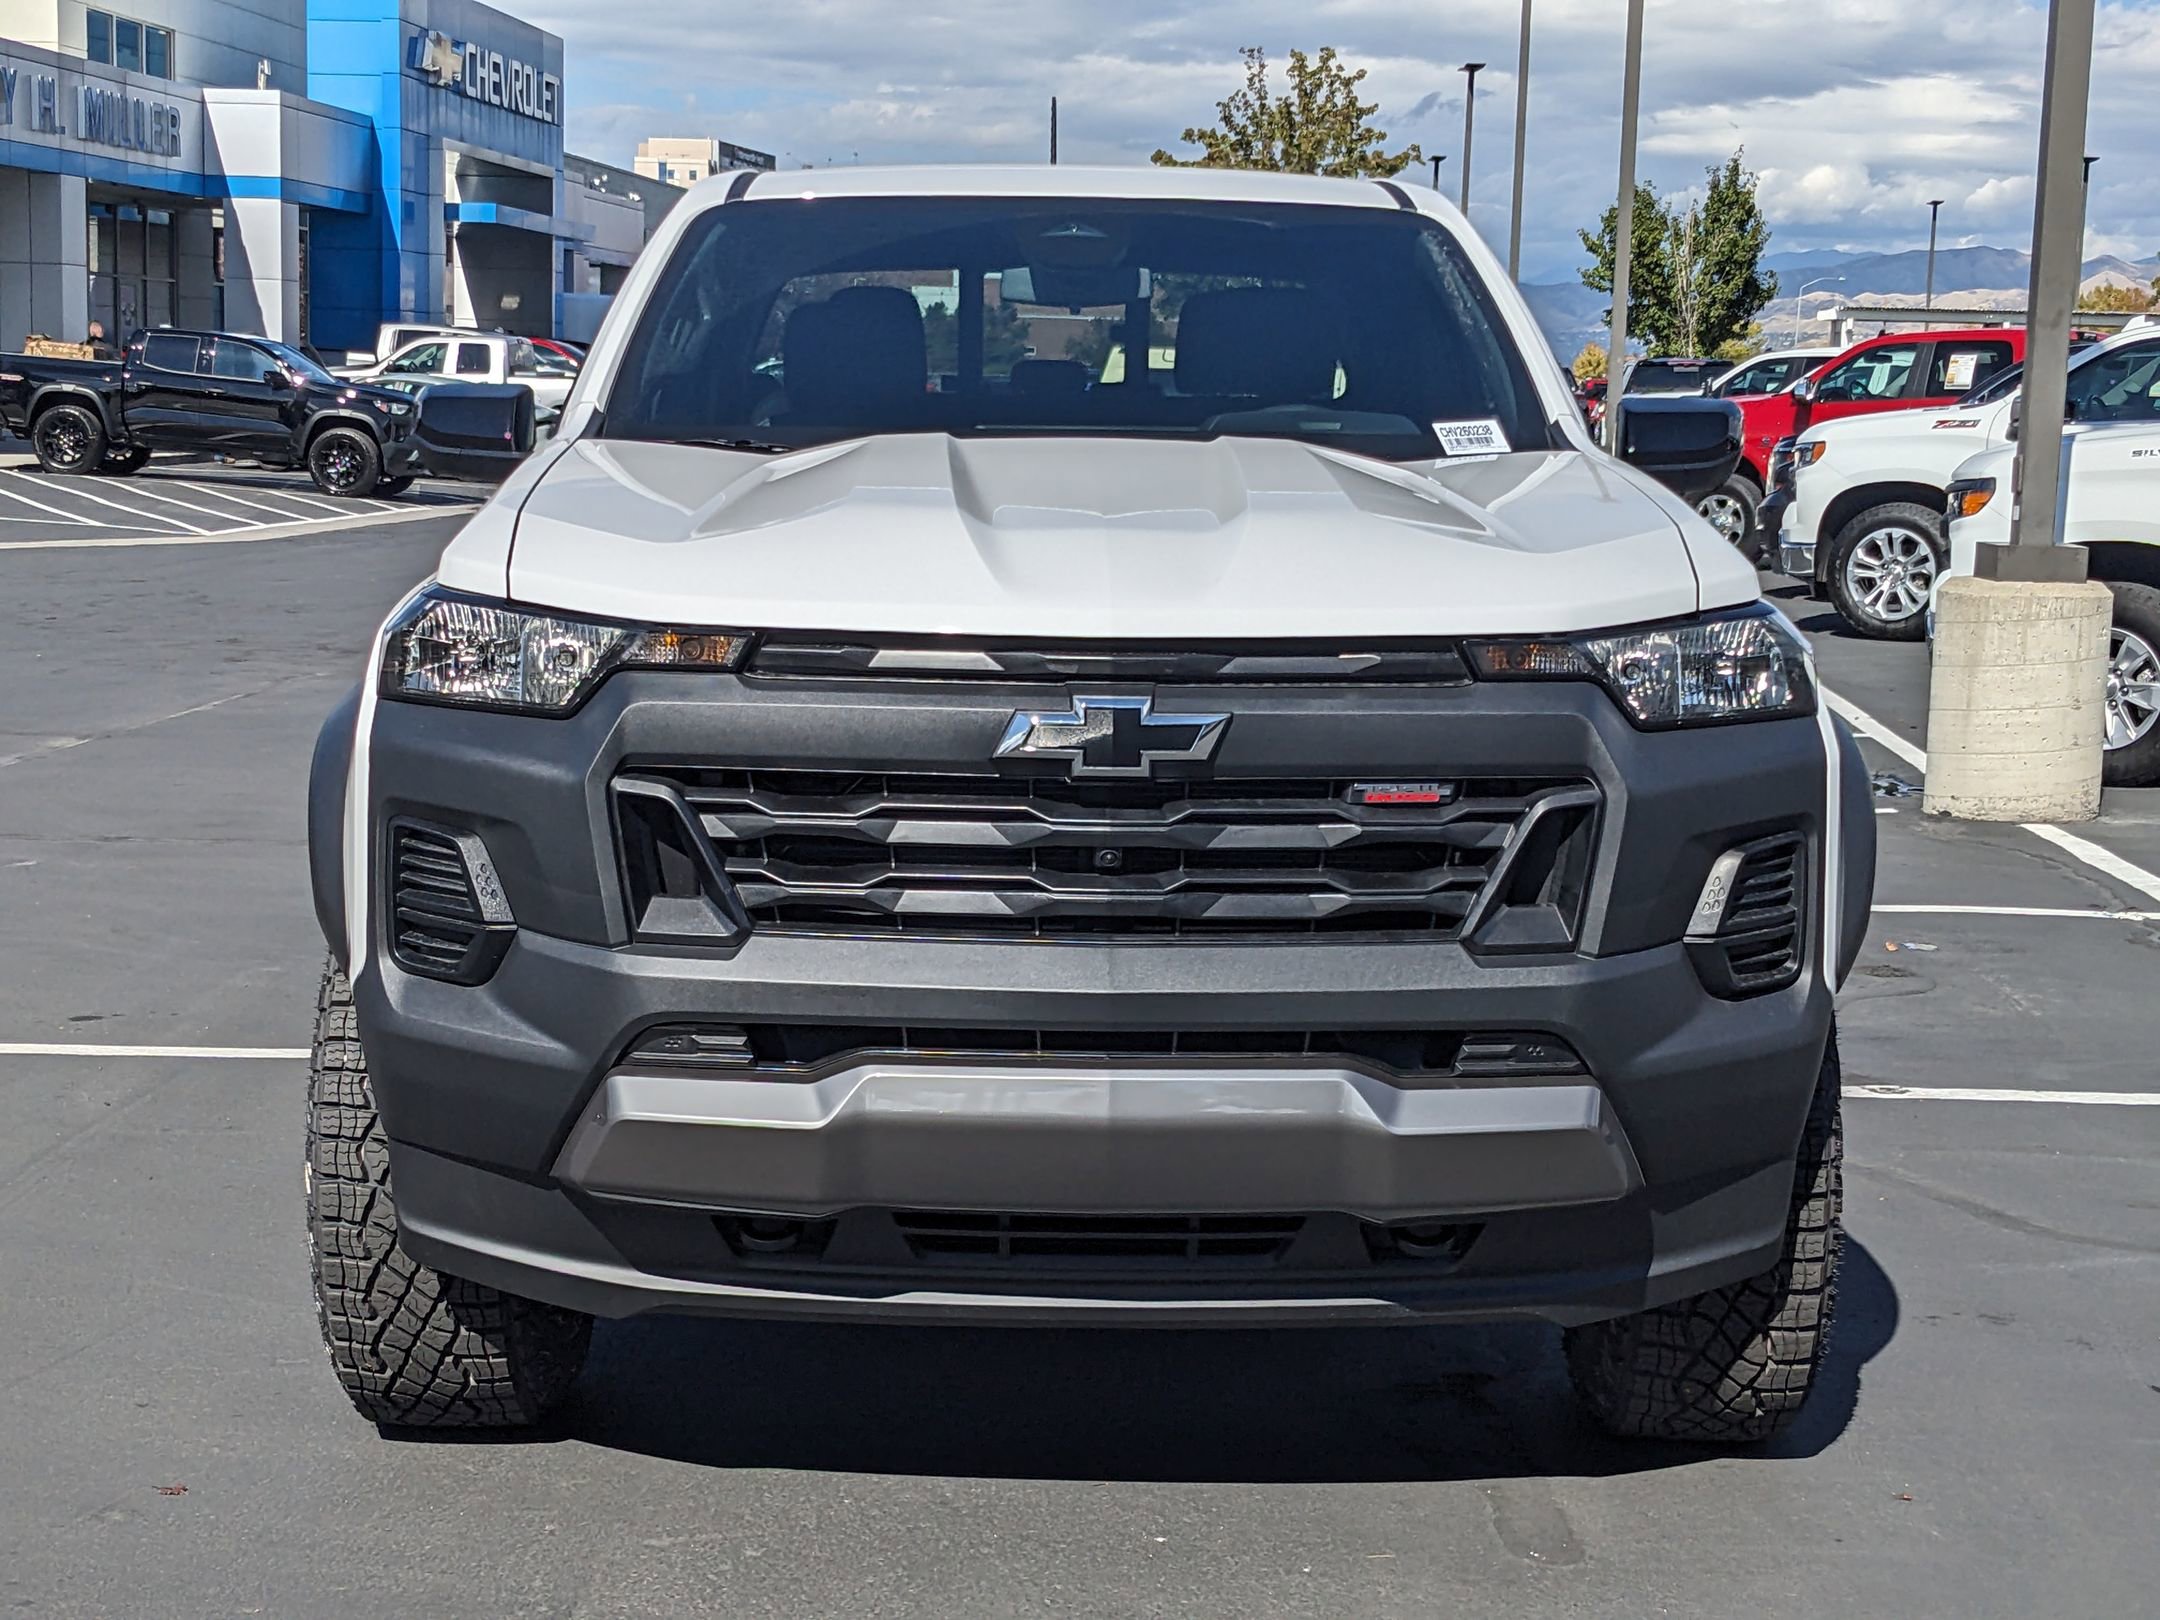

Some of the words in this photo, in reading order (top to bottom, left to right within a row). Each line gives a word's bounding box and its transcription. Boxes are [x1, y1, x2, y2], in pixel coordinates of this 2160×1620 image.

[466, 42, 560, 124] CHEVROLET
[77, 86, 182, 157] MILLER
[1439, 424, 1493, 438] CHV260238
